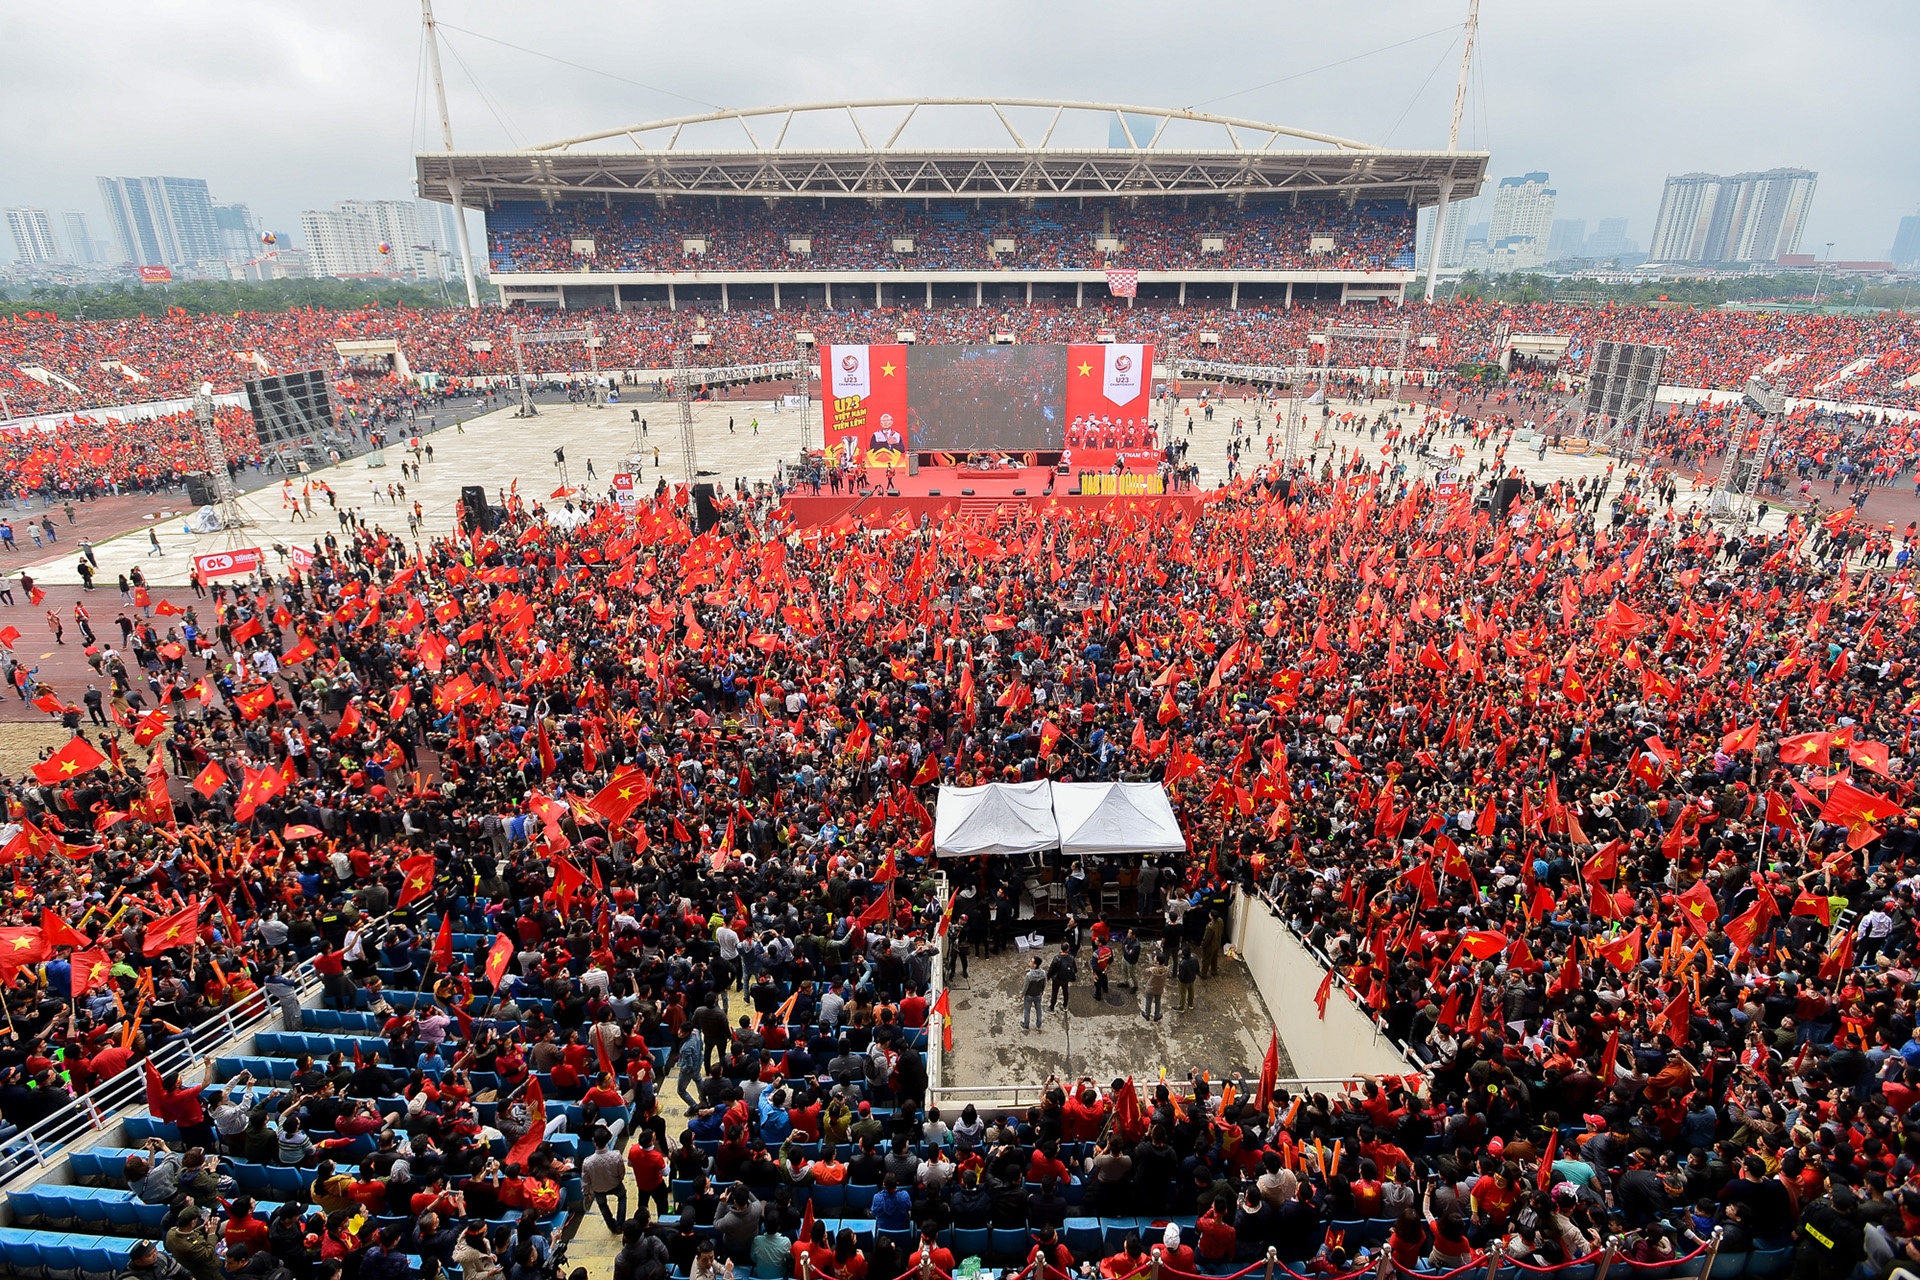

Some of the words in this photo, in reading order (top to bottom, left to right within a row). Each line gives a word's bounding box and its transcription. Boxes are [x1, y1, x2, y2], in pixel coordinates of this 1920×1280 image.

[834, 395, 860, 412] U23
[851, 408, 866, 417] NAM
[207, 557, 226, 568] OK
